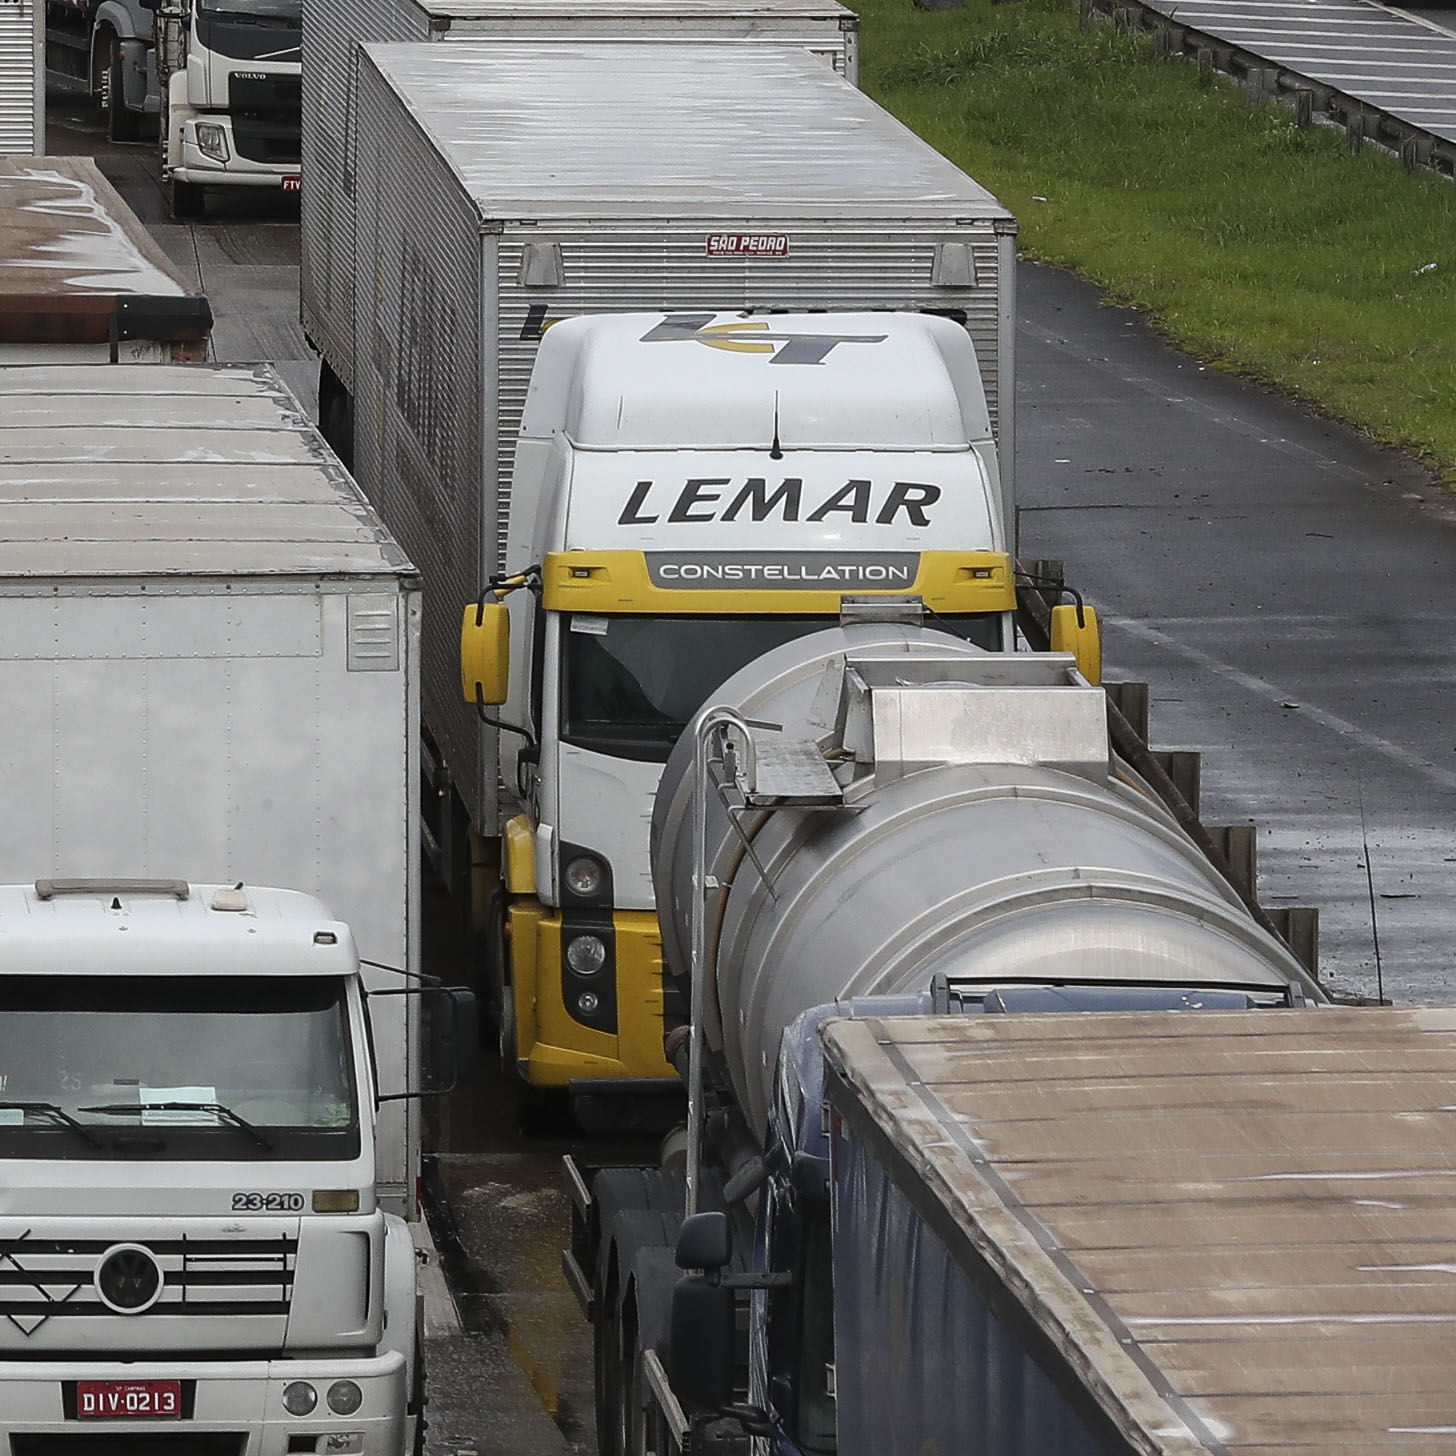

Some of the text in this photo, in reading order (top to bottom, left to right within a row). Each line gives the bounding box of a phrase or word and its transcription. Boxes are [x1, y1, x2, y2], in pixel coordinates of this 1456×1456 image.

[709, 234, 786, 250] SÃO PEDRO
[617, 478, 941, 527] LEMAR
[658, 563, 909, 582] CONSTELLATION
